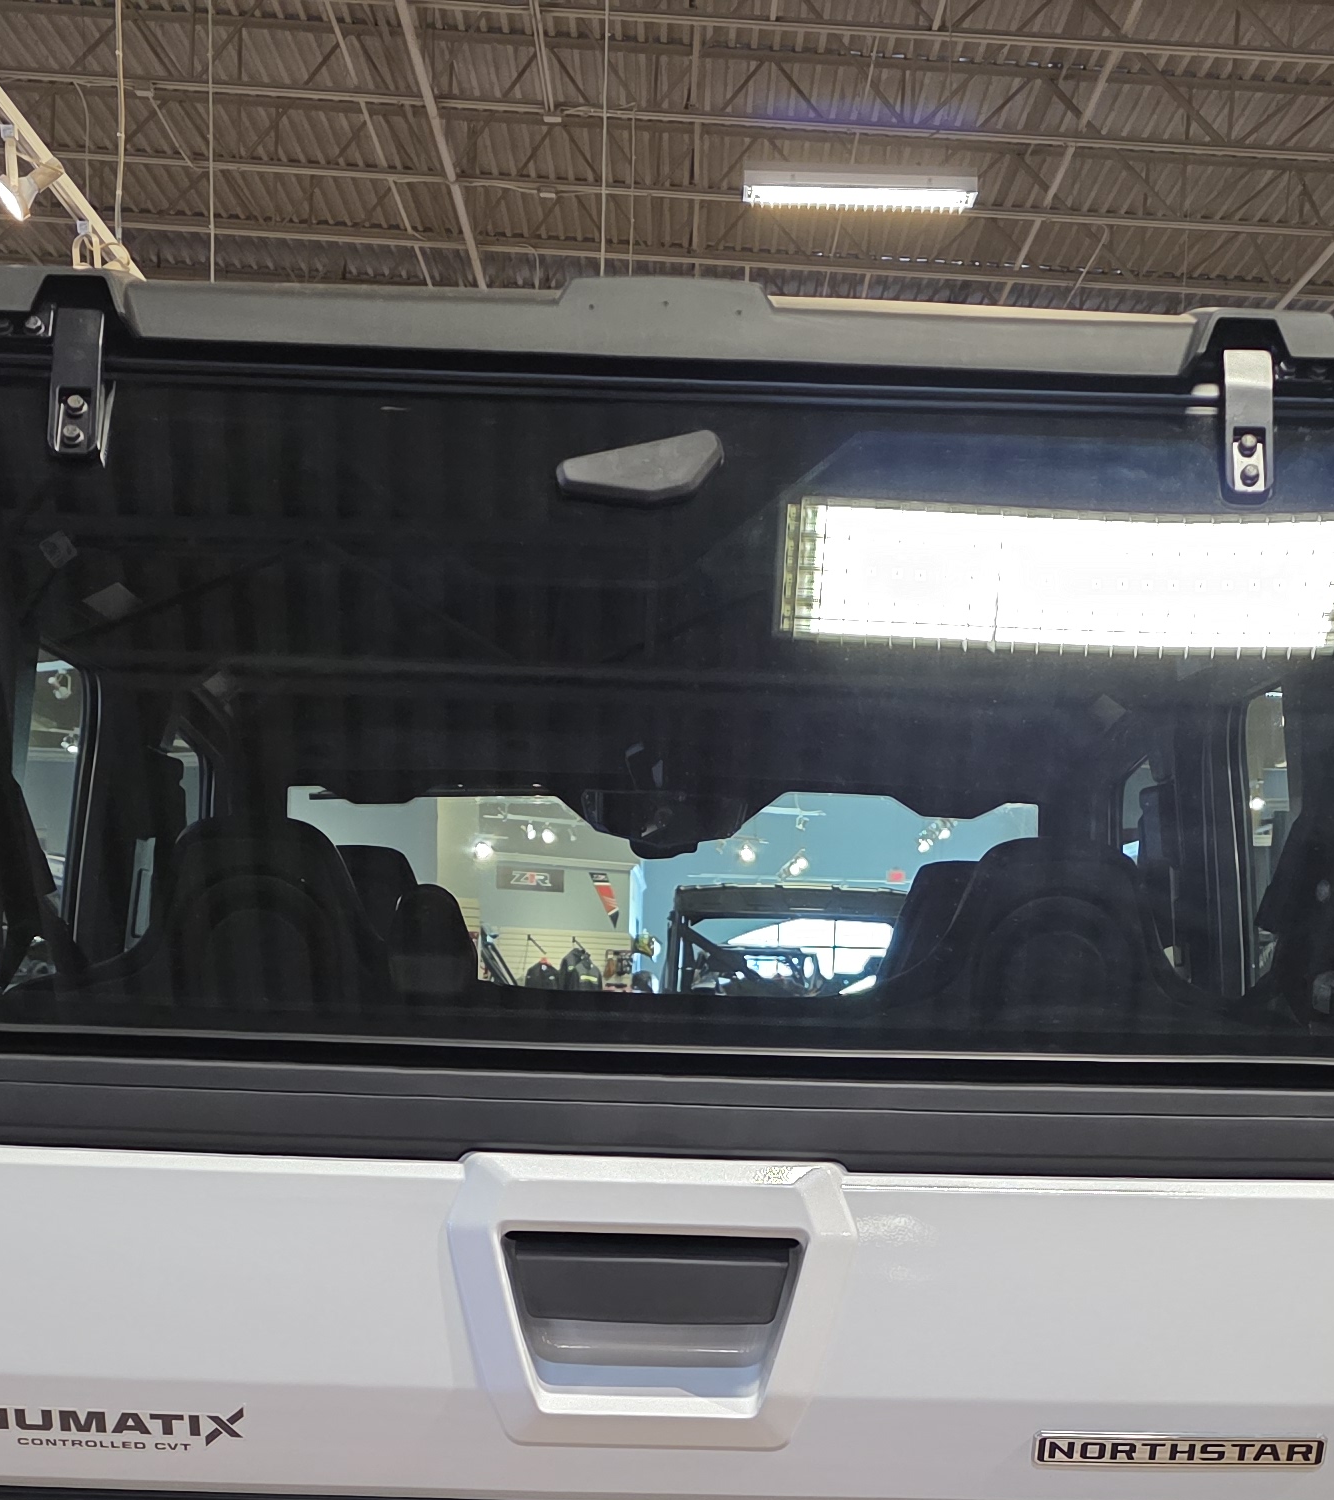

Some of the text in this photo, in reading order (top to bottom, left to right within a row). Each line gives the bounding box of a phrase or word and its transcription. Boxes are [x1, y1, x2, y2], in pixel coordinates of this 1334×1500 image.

[16, 1437, 192, 1452] CONTROLLED CVT
[1047, 1440, 1314, 1462] NORTHSTAR
